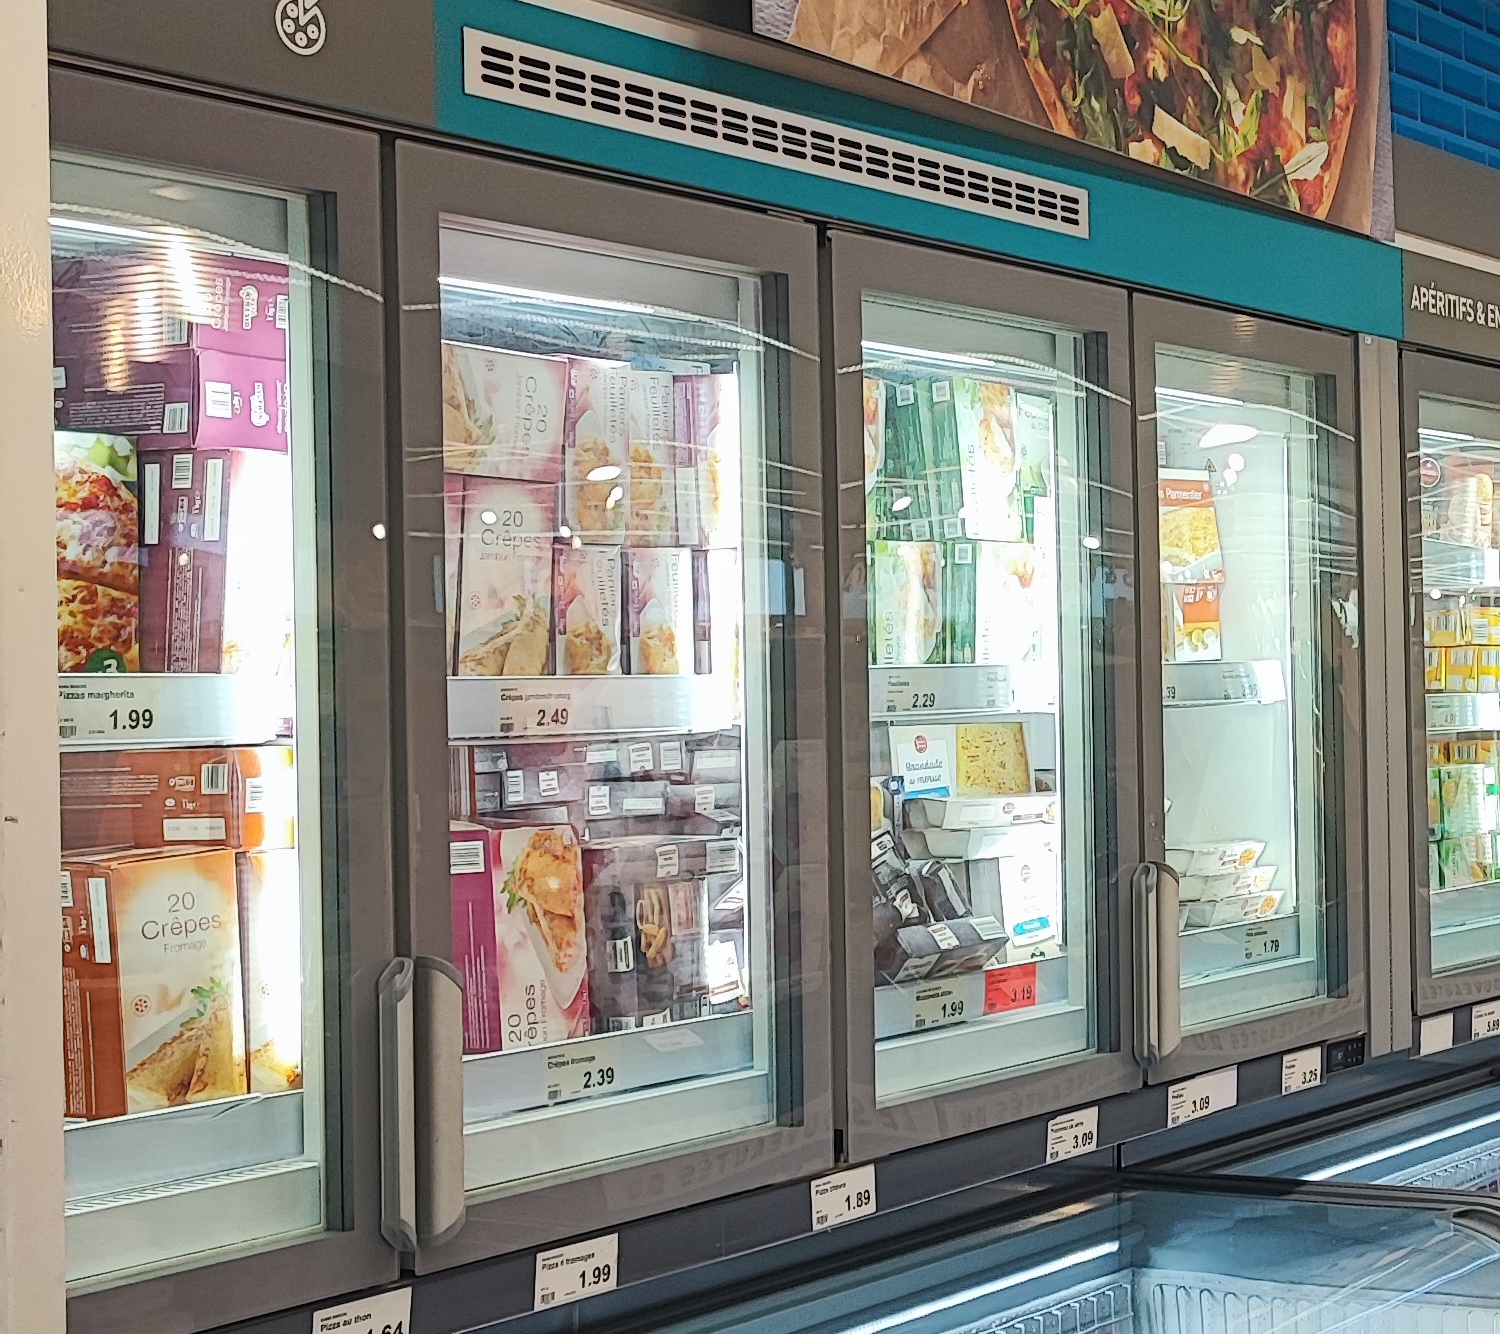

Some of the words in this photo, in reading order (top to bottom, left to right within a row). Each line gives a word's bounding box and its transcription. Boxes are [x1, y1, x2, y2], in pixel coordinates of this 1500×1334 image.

[1411, 281, 1475, 323] APÉRITIFS
[1476, 300, 1486, 326] &
[502, 509, 524, 528] 20
[480, 528, 542, 550] Crêpes
[912, 693, 936, 708] 2.29
[109, 708, 154, 730] 1.99
[536, 707, 569, 727] 2.49
[166, 891, 197, 914] 20
[140, 916, 222, 941] Crêpes
[941, 1001, 964, 1019] 1.99
[583, 1067, 614, 1090] 2.39
[845, 1189, 871, 1212] 1.89
[579, 1263, 611, 1289] 1.99
